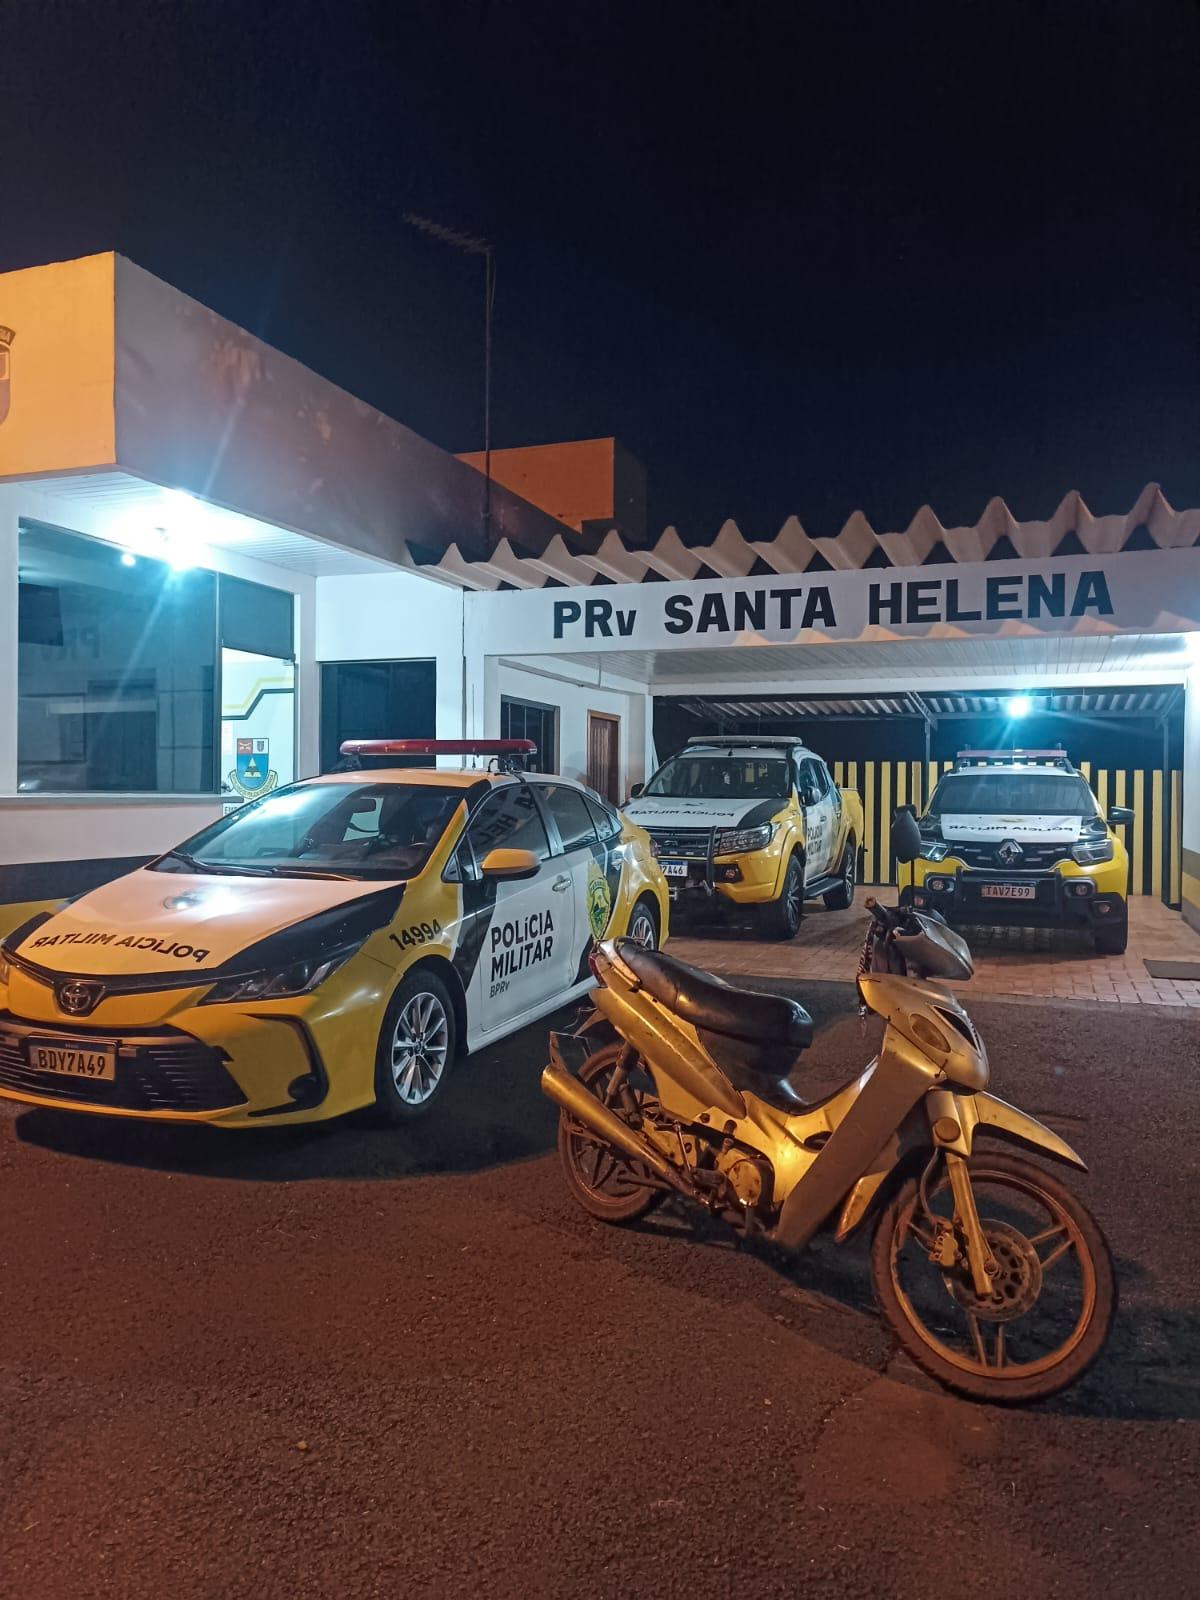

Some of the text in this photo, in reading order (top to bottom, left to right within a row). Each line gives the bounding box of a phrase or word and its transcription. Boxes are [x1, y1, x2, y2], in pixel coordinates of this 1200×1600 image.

[553, 570, 1115, 639] PRv SANTA HELENA
[389, 918, 442, 951] 14994
[490, 936, 553, 982] MILITAR
[38, 1050, 106, 1076] BDY7A49
